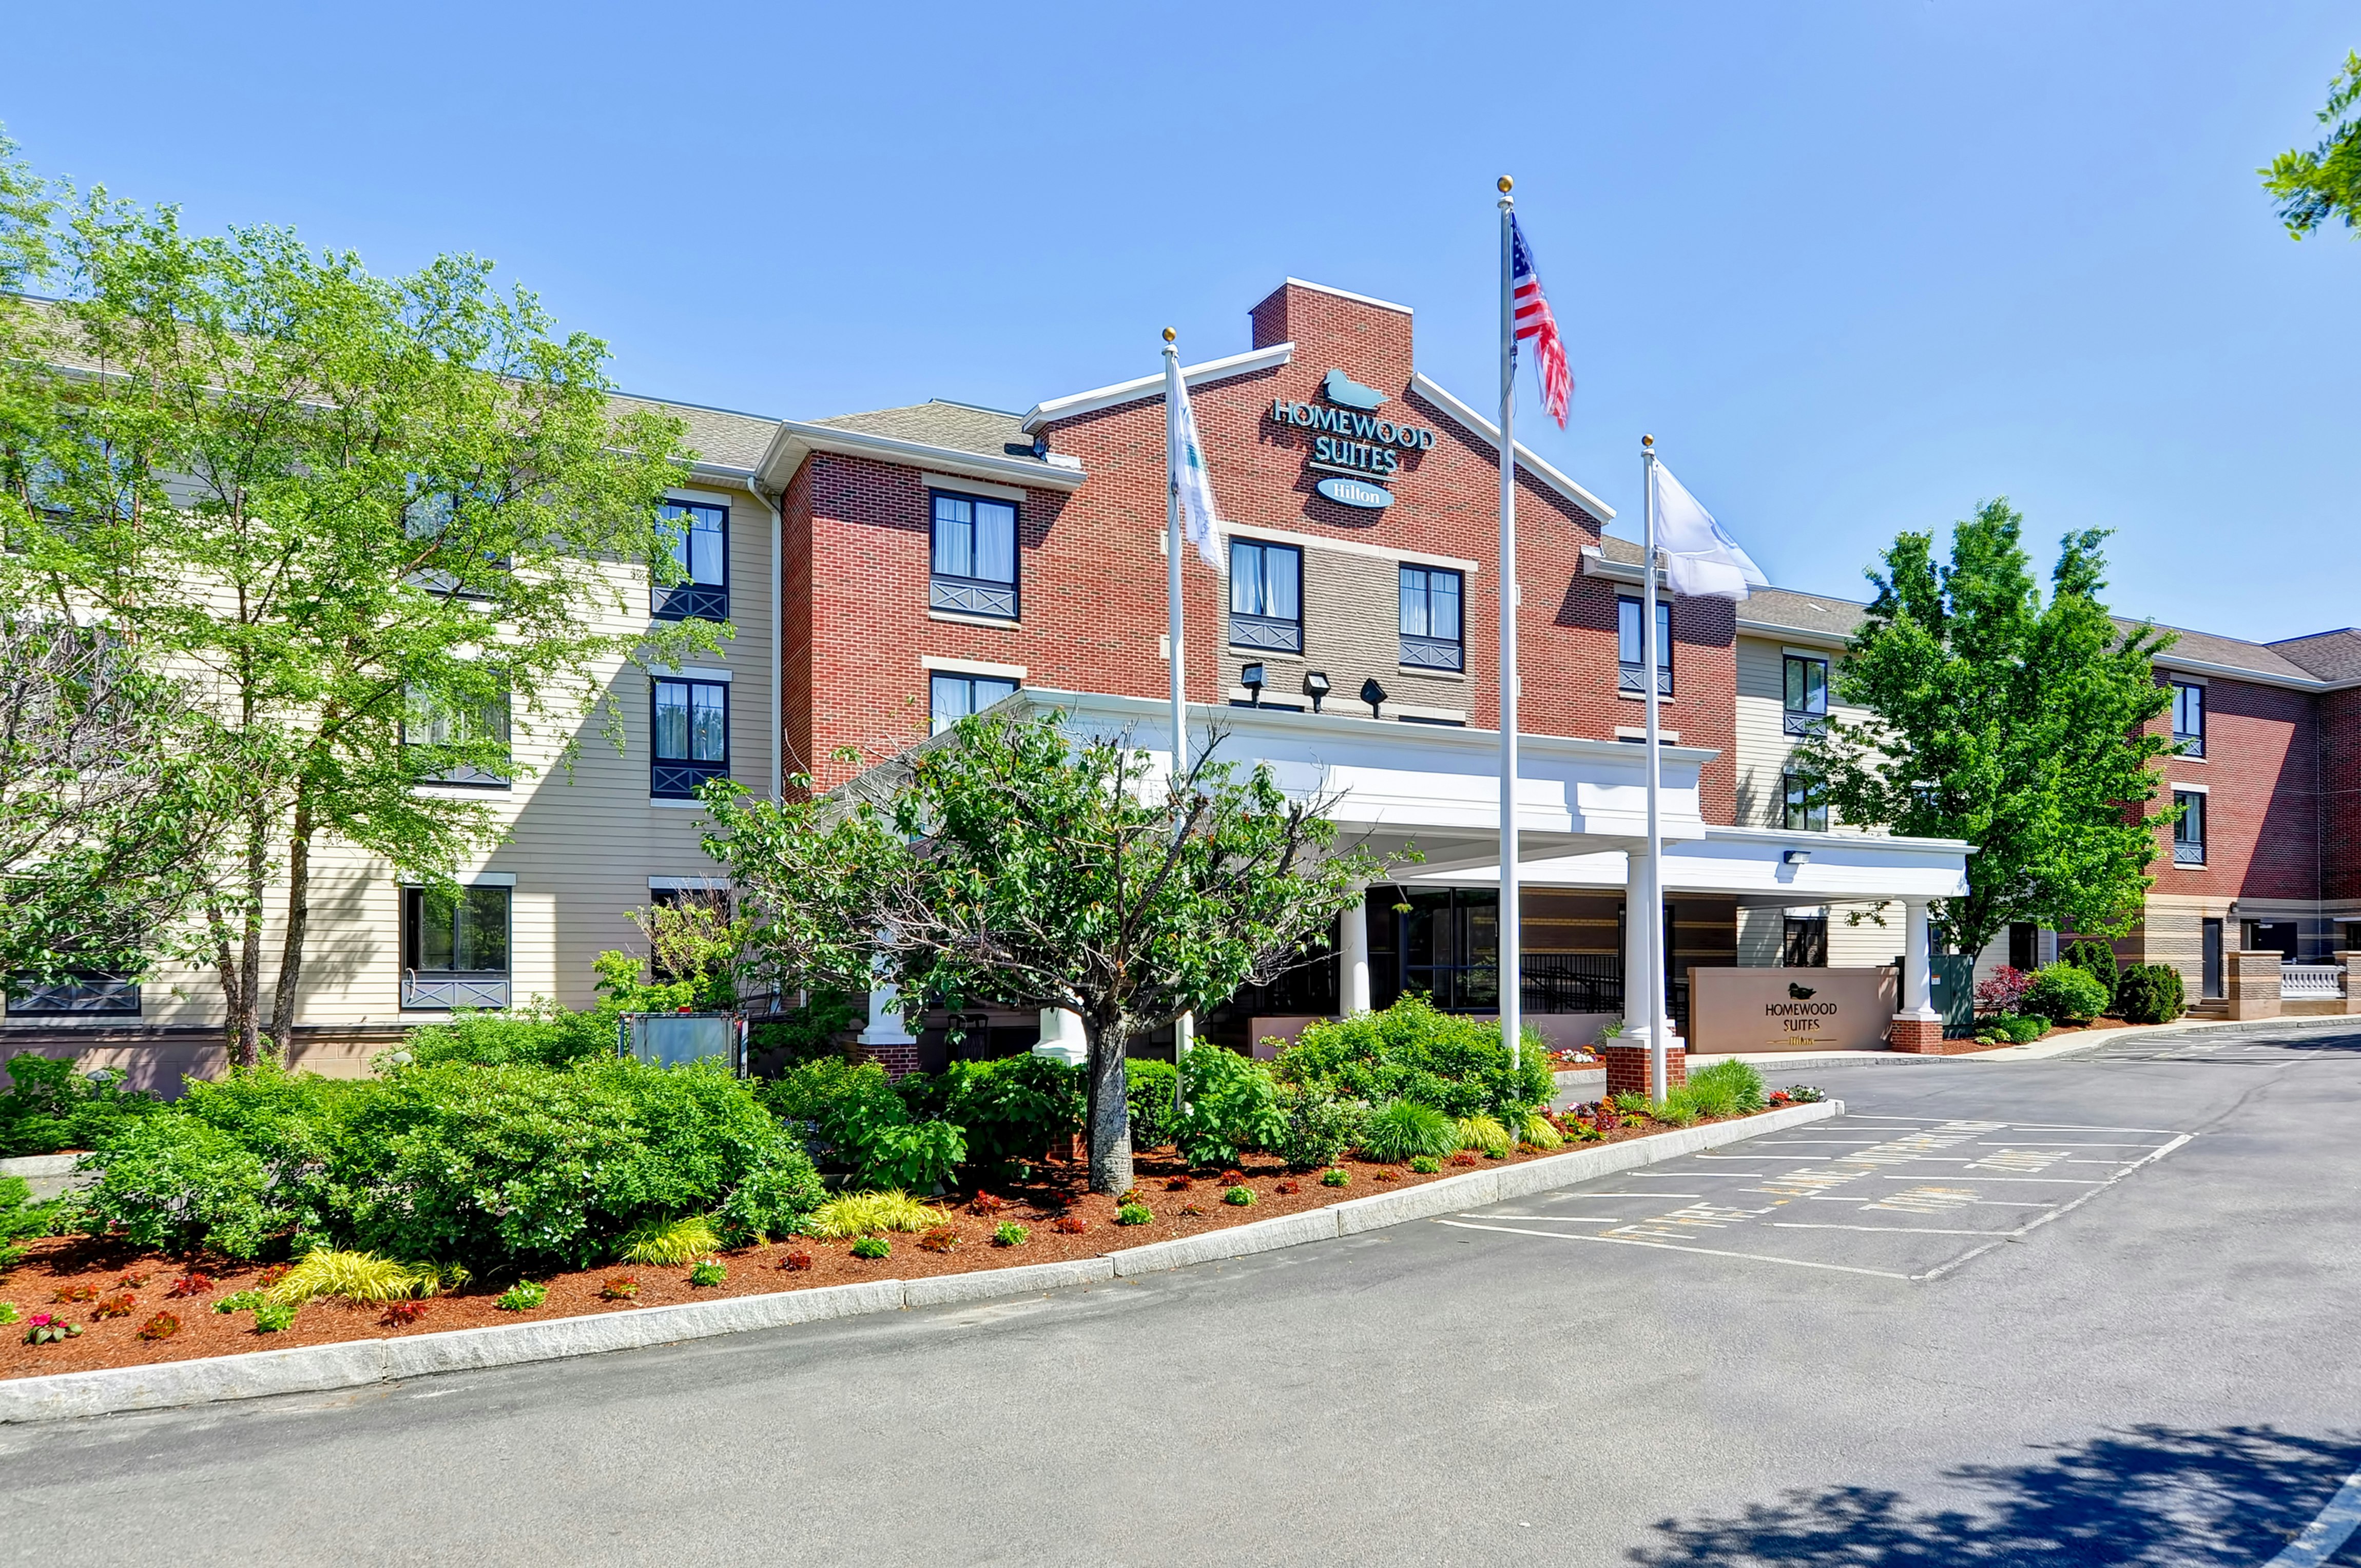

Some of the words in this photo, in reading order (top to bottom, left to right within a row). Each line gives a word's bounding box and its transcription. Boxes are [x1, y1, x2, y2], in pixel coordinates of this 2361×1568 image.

[1272, 397, 1437, 451] HOMEWOOD
[1314, 436, 1399, 473] SUITES
[1333, 482, 1381, 505] Hilton
[1765, 1002, 1837, 1016] HOMEWOOD
[1783, 1018, 1820, 1032] SUITES
